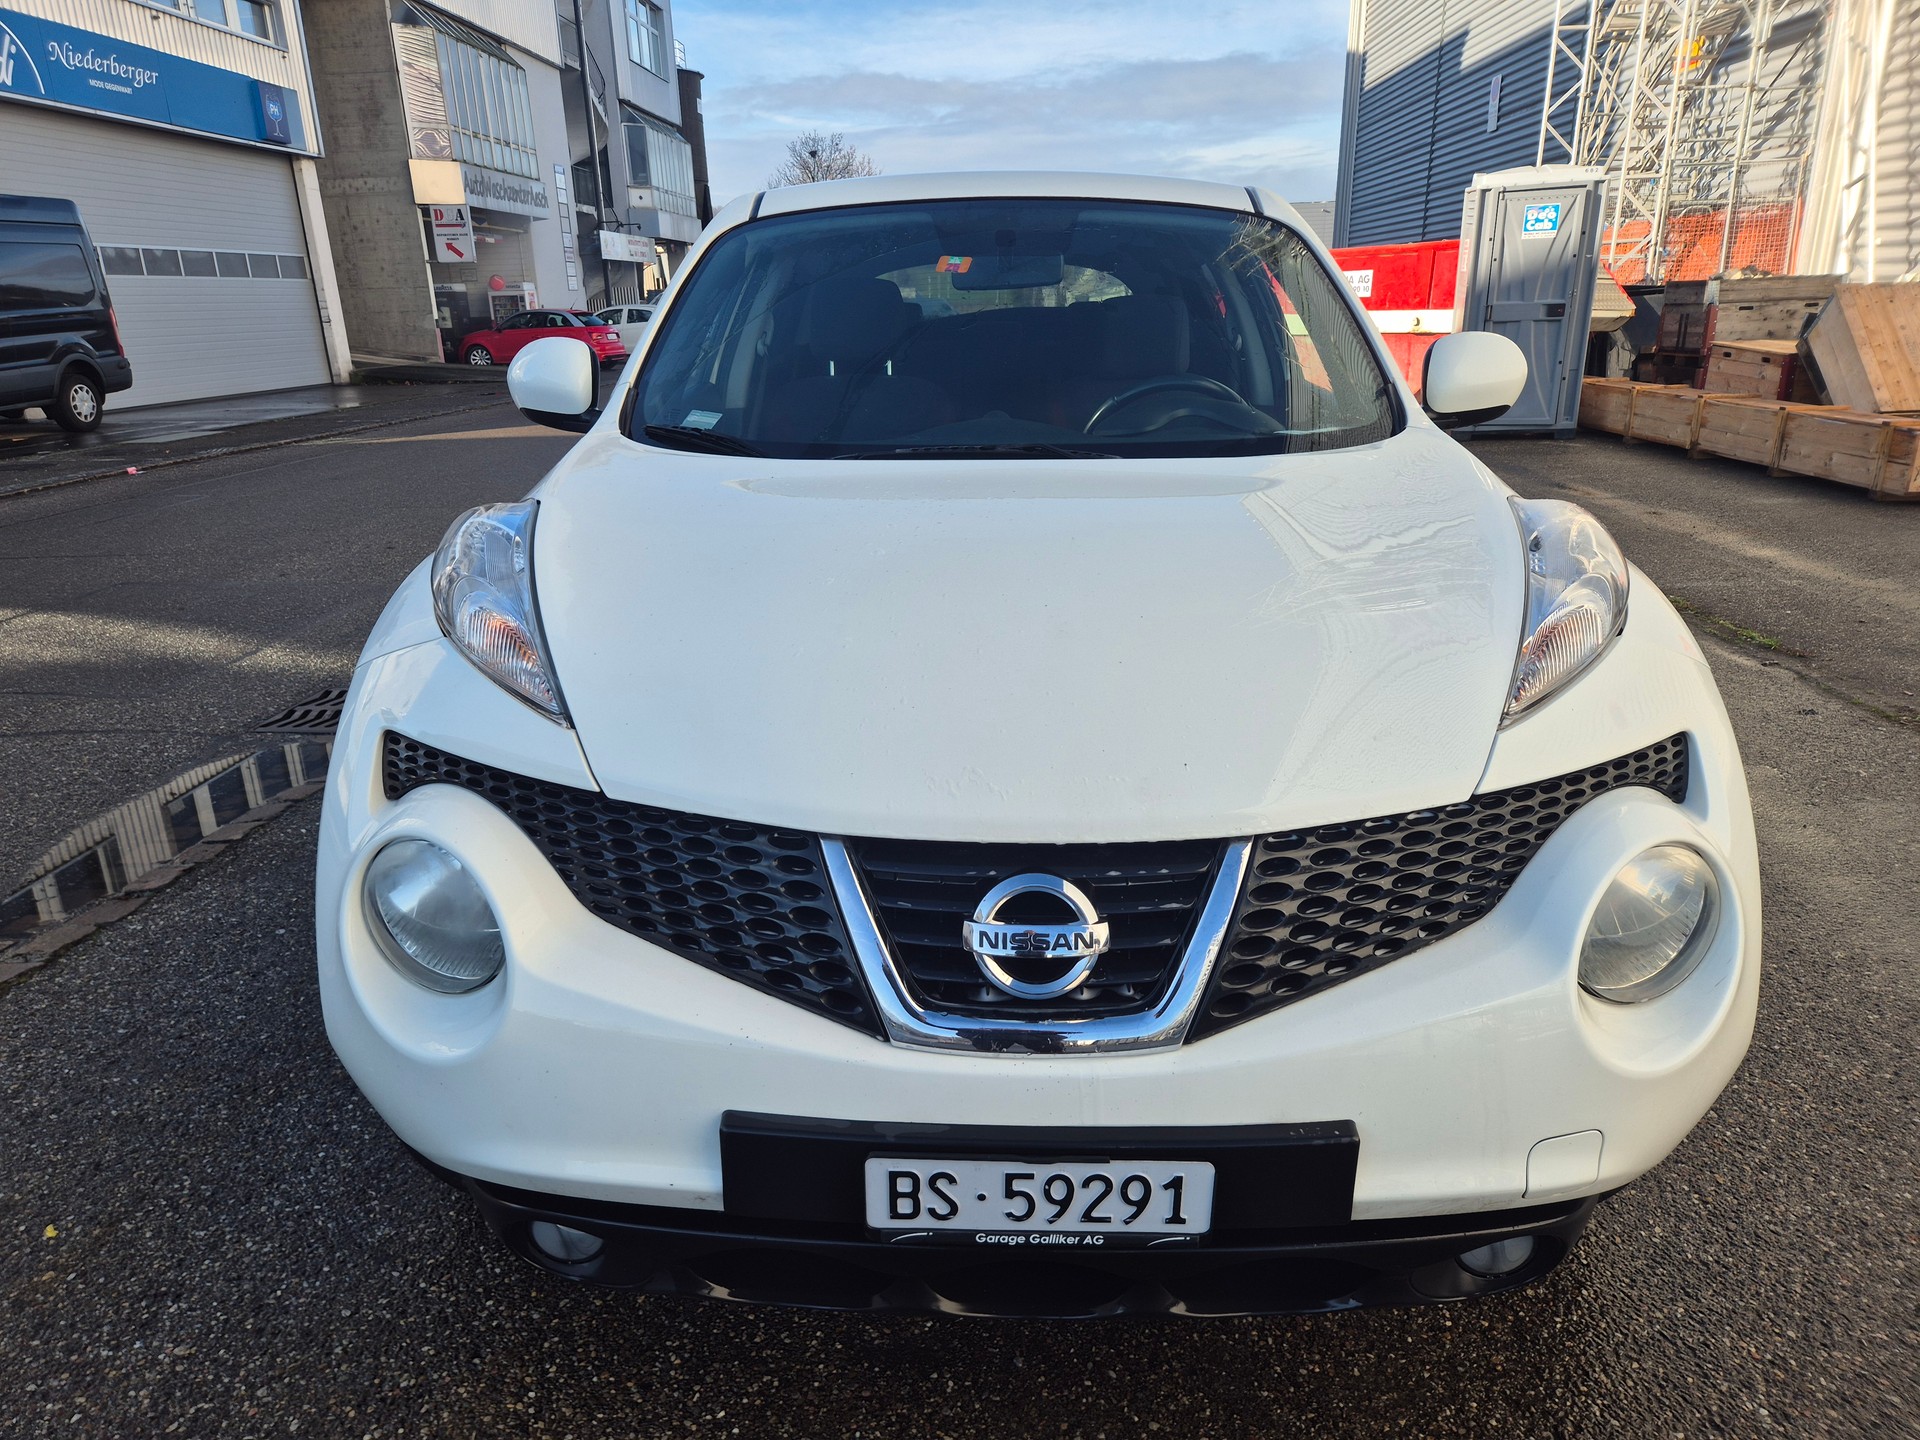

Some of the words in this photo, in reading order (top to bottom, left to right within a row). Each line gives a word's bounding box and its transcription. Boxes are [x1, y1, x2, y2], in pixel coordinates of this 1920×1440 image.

[48, 41, 159, 88] Niederberger
[1527, 209, 1557, 221] Deo
[1525, 218, 1553, 231] Cab
[1357, 275, 1370, 284] AG
[979, 930, 1095, 952] NISSAN
[975, 1232, 1026, 1246] Garage
[1029, 1233, 1080, 1245] Galliker
[1082, 1234, 1105, 1245] AG
